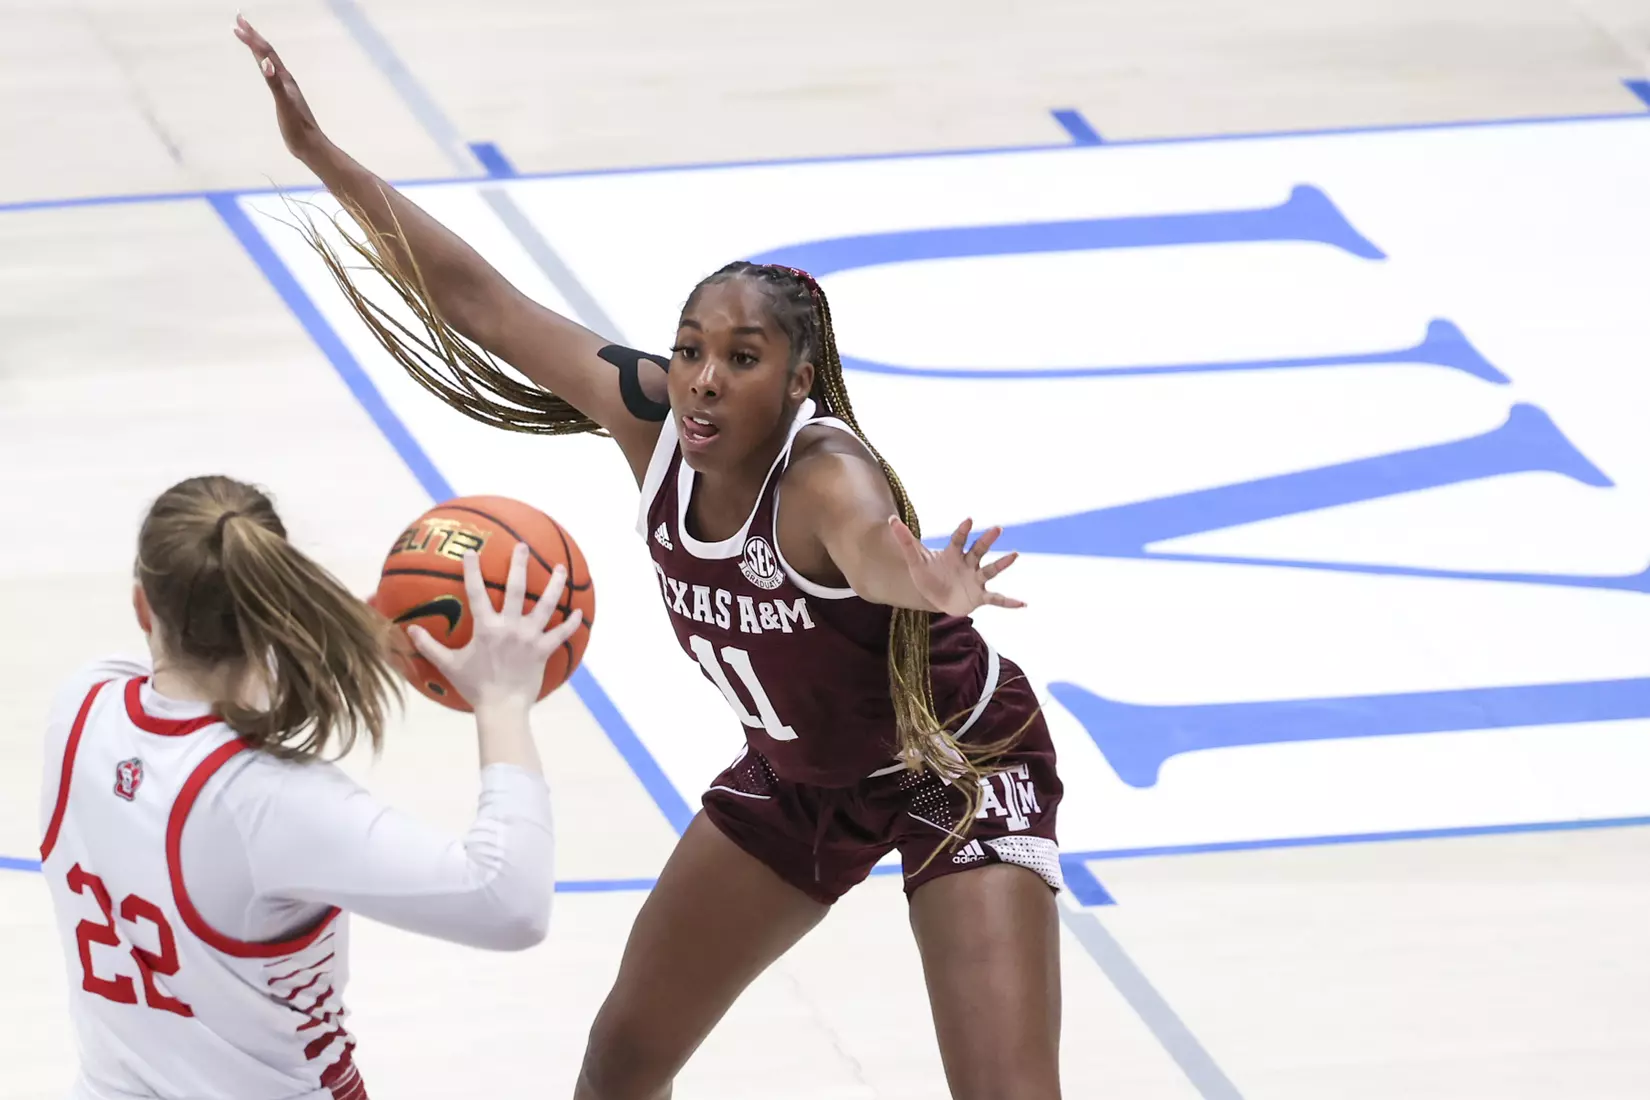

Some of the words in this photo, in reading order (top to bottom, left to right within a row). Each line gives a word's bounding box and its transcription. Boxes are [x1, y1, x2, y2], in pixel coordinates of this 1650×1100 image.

[746, 539, 775, 578] SEC
[744, 569, 782, 589] GRADUATE
[737, 595, 815, 634] A&M
[689, 634, 799, 741] 11
[66, 862, 194, 1018] 22
